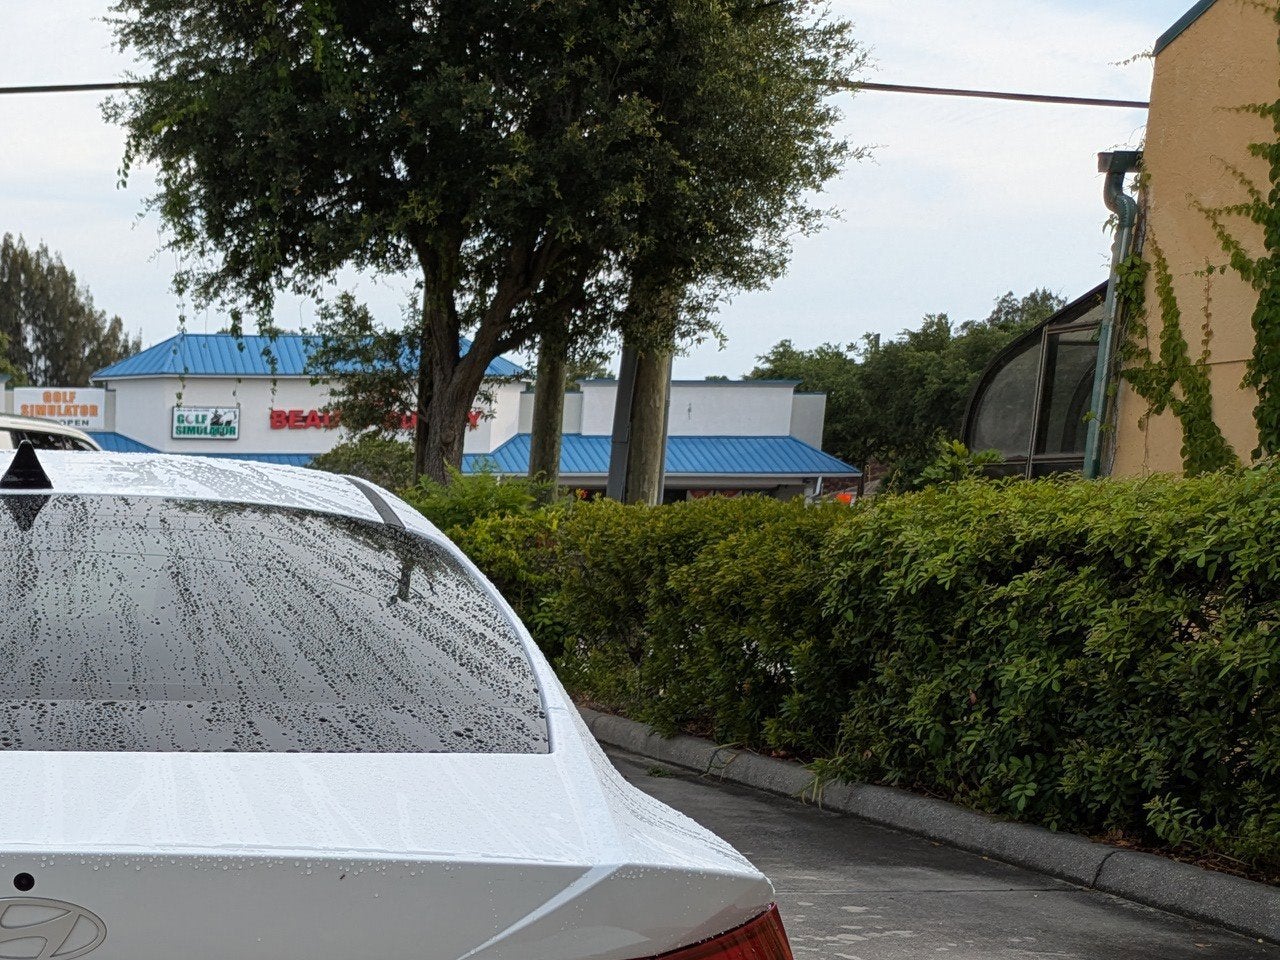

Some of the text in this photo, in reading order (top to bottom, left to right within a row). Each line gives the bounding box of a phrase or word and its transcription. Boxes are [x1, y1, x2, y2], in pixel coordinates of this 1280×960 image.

[42, 390, 76, 404] GOLF
[20, 403, 99, 418] SIMULATOR
[176, 413, 208, 425] GOLF
